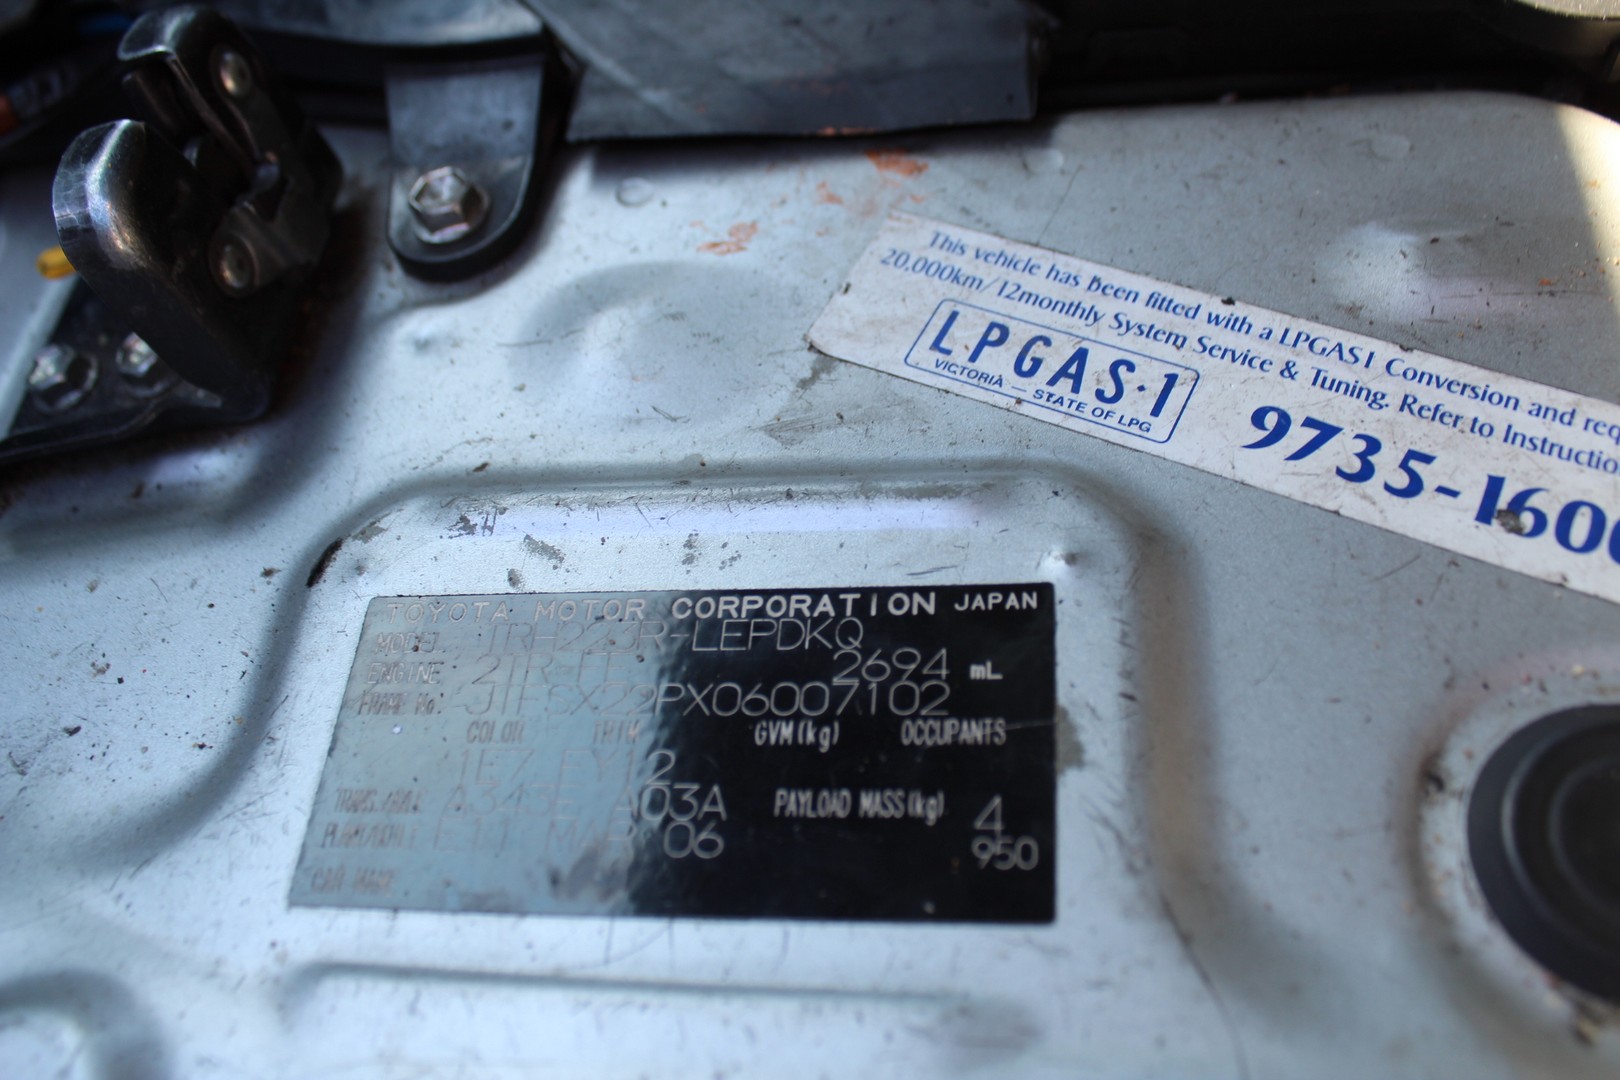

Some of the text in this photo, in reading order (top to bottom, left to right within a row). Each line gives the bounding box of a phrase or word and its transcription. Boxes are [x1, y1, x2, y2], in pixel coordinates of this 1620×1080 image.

[928, 231, 966, 255] This
[974, 246, 1040, 277] vehicle
[1046, 263, 1080, 288] has
[1087, 276, 1139, 305] been
[1145, 290, 1202, 321] fitted
[1206, 310, 1254, 336] with
[1259, 327, 1272, 341] a
[1384, 356, 1522, 411] Conversion
[1528, 400, 1576, 427] and
[933, 358, 1004, 388] VICTORIA
[1033, 389, 1086, 413] STATE
[1091, 406, 1115, 421] OF
[1117, 414, 1152, 433] LPG
[1108, 312, 1187, 352] System
[1192, 334, 1274, 373] Service
[1279, 359, 1299, 381] &
[1310, 366, 1390, 410] Tuning.
[1399, 392, 1465, 428] Refer
[1469, 418, 1495, 438] to
[1503, 424, 1620, 475] Instructio
[1242, 405, 1620, 564] 9735-160
[387, 591, 1038, 624] TOYOTA MOTOR CORPORATION JAPAN
[367, 661, 445, 685] ENGINE
[833, 648, 951, 681] 2694
[970, 660, 1003, 681] mL
[902, 718, 1006, 746] OCCUPANTS
[773, 788, 851, 818] PAYLOAD
[974, 795, 1005, 838] 4
[663, 820, 725, 859] 06
[971, 837, 1039, 870] 950
